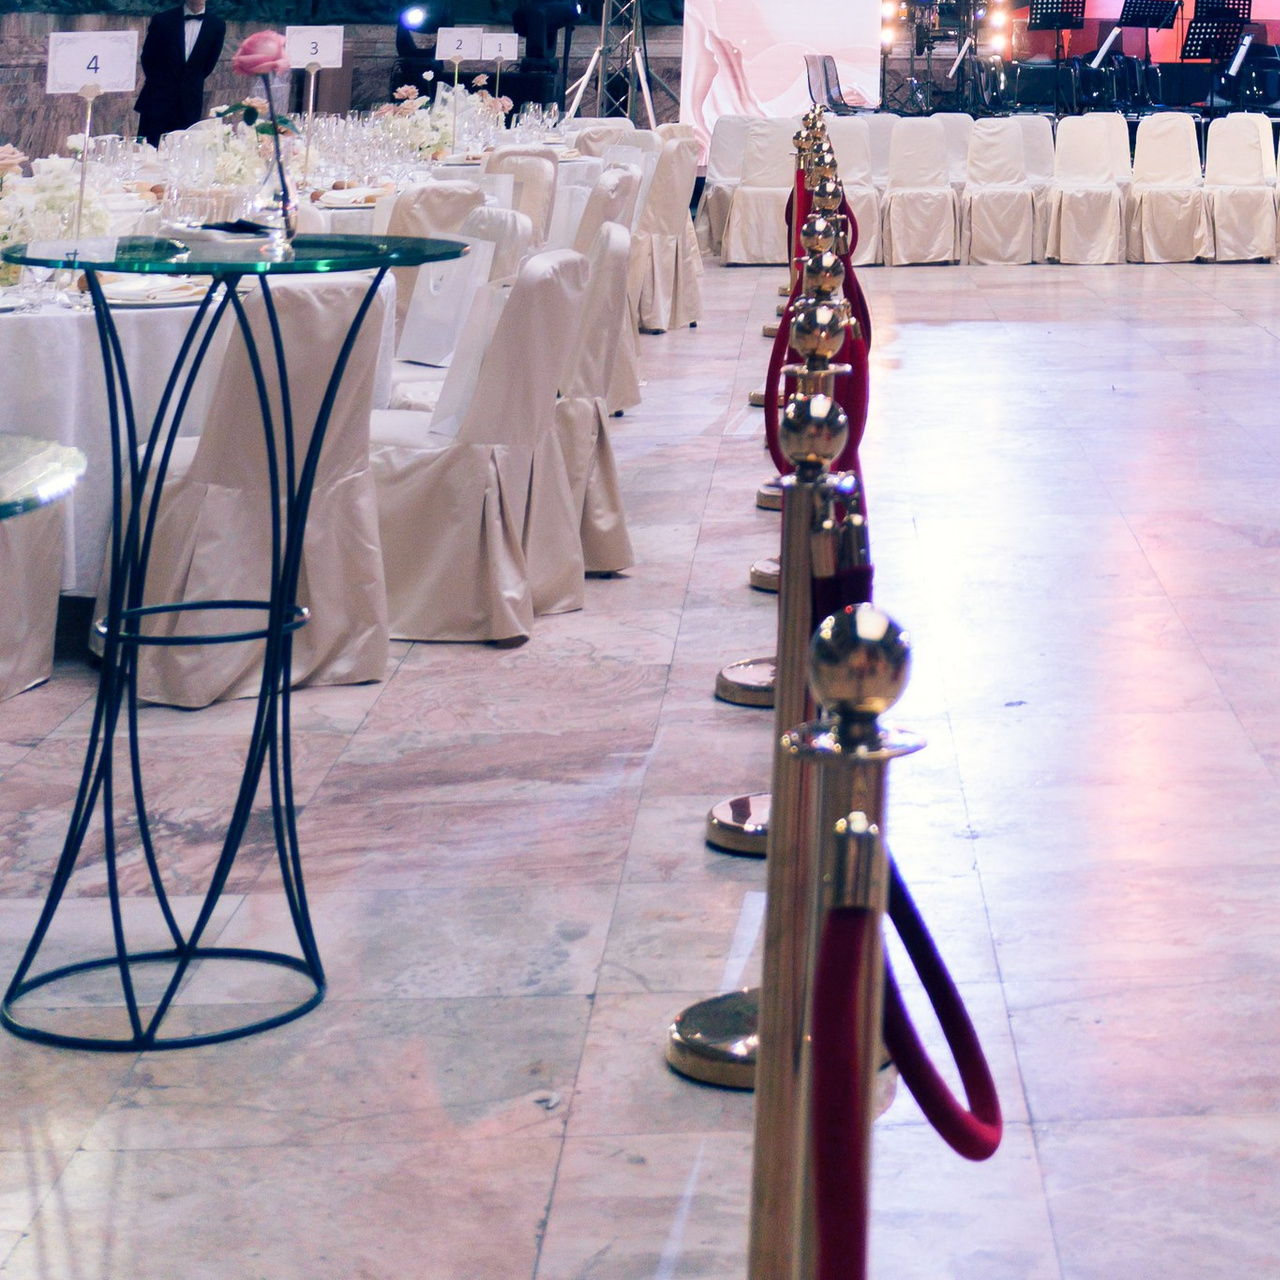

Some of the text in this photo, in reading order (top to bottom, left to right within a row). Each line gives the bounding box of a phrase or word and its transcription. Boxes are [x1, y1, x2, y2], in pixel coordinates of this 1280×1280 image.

[310, 41, 319, 56] 3
[455, 39, 463, 50] 2
[497, 43, 503, 52] 1
[86, 54, 100, 74] 4
